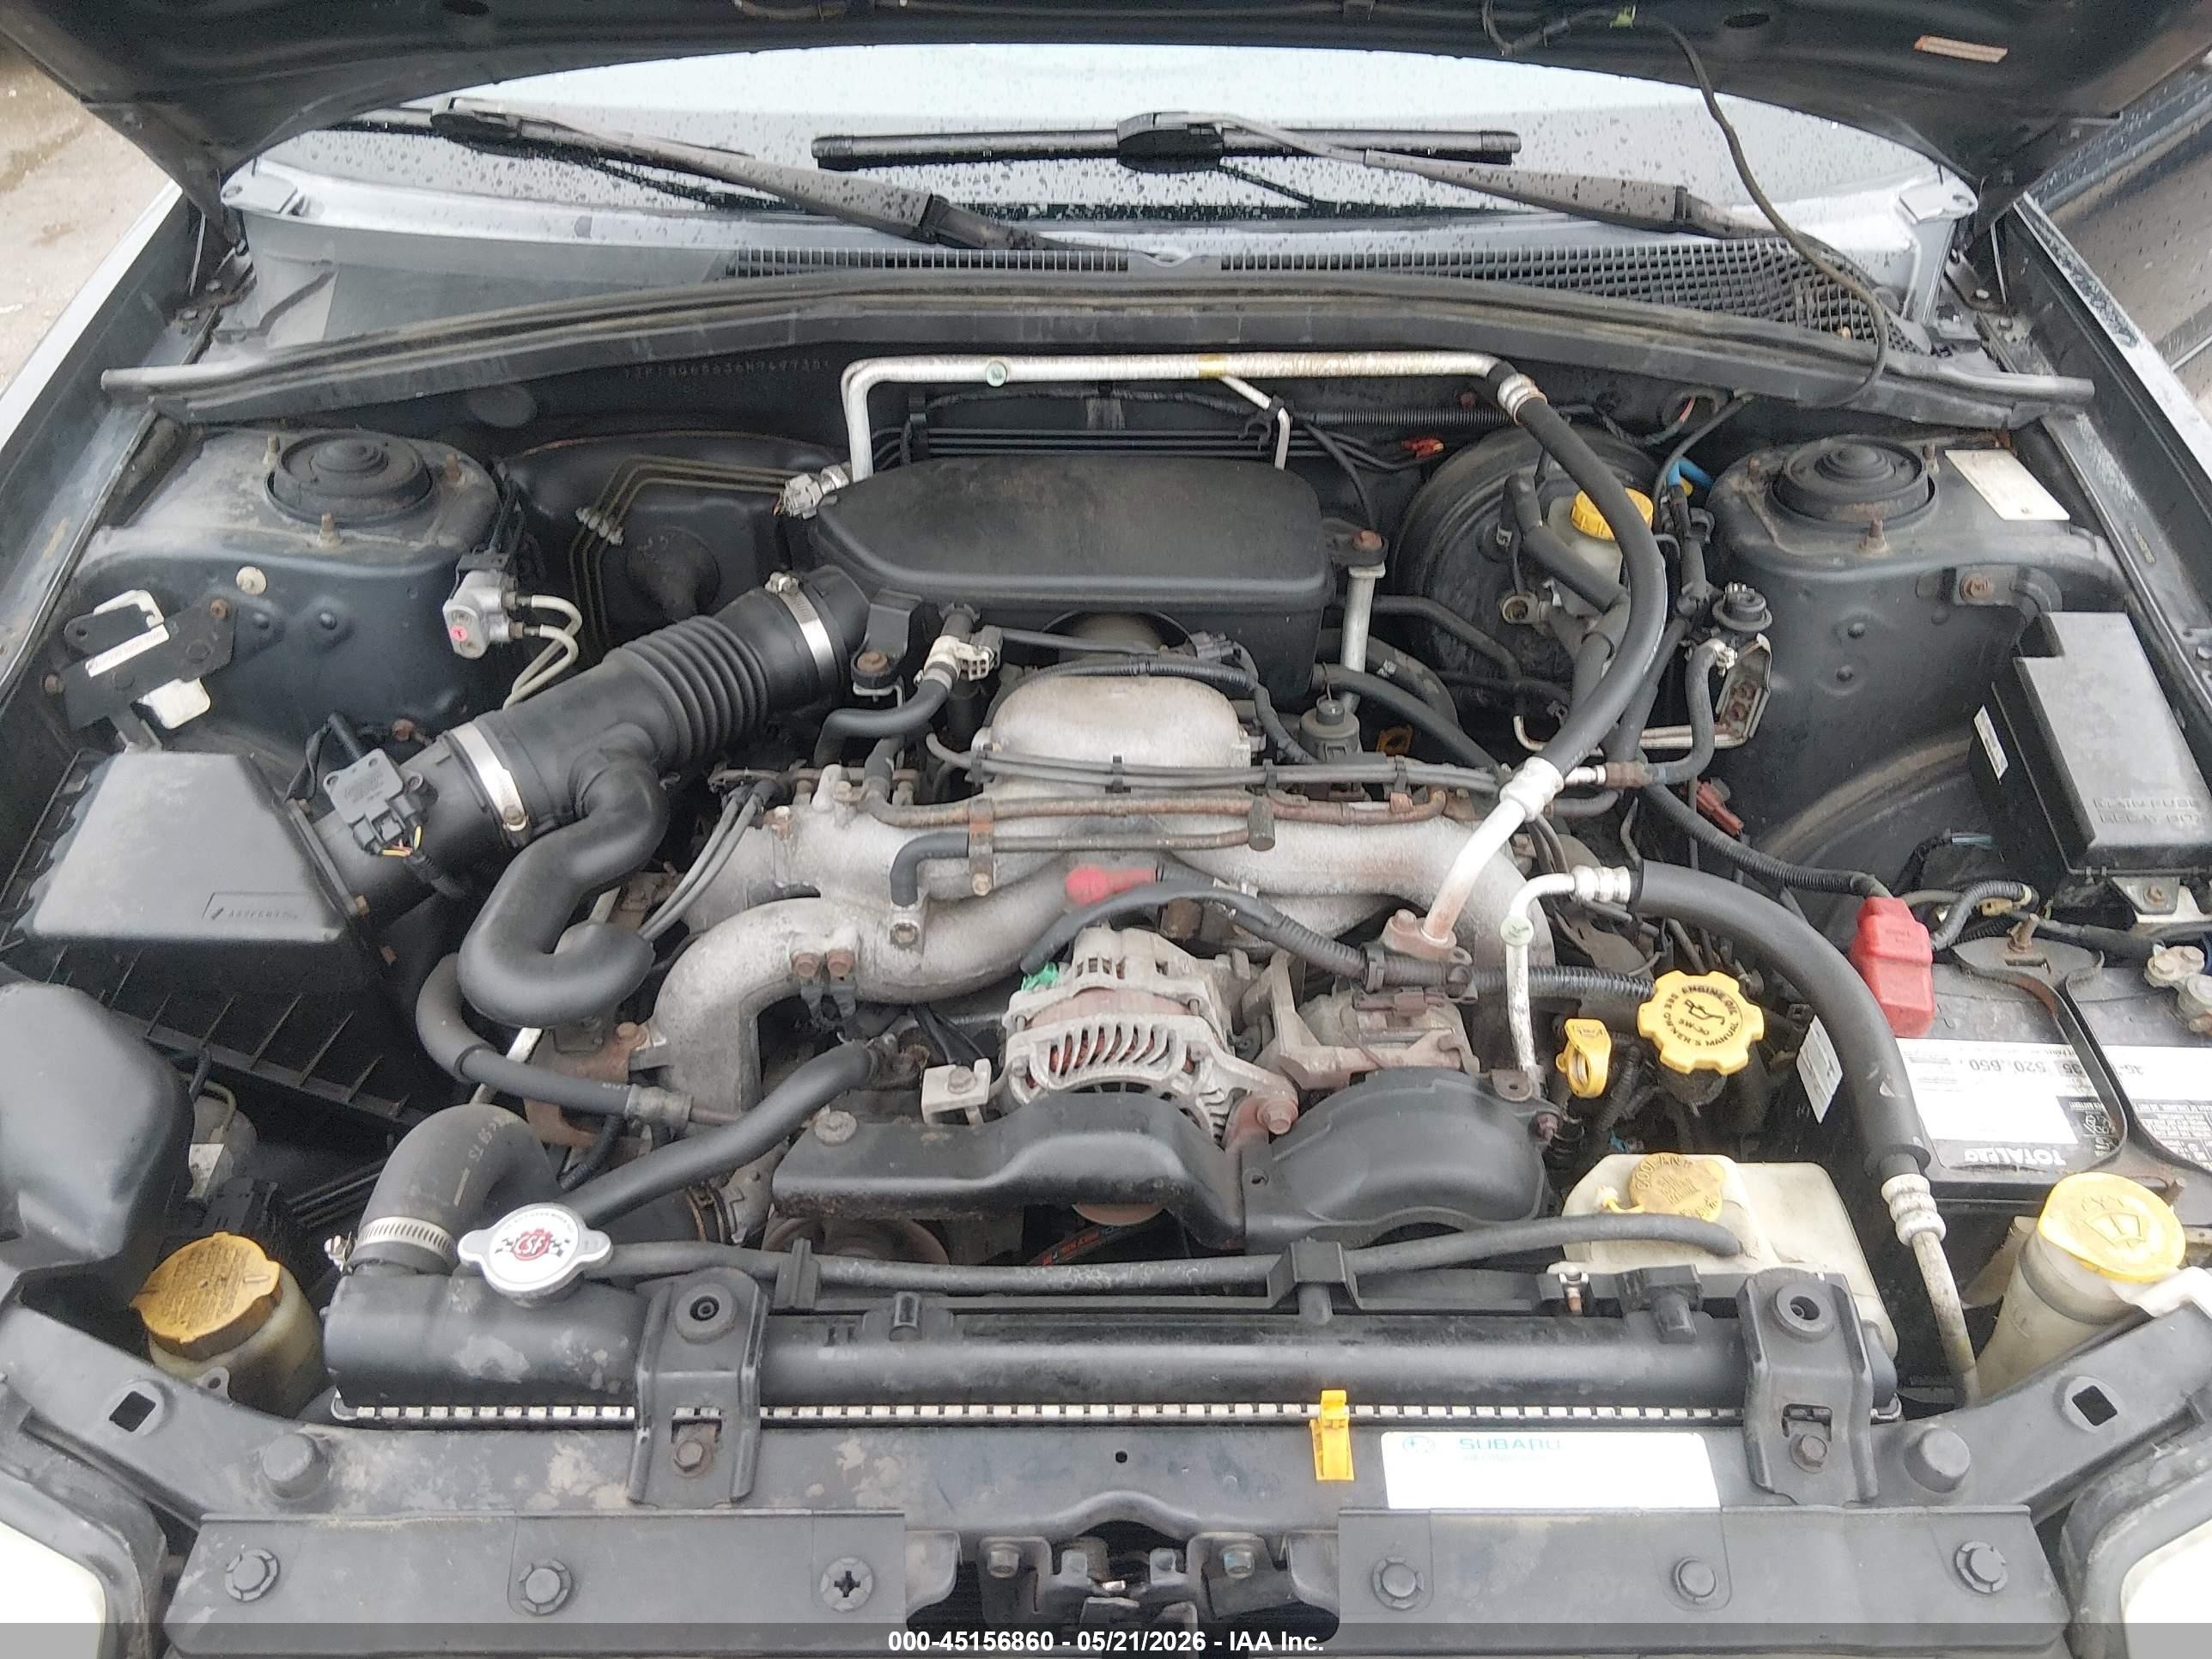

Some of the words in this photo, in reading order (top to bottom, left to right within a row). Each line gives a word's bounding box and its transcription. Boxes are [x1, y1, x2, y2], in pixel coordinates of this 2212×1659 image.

[1680, 984, 1726, 1001] ENGINE
[1724, 999, 1738, 1016] OIL
[1705, 1021, 1740, 1047] MANUAL
[1459, 1437, 1561, 1450] SUBARU
